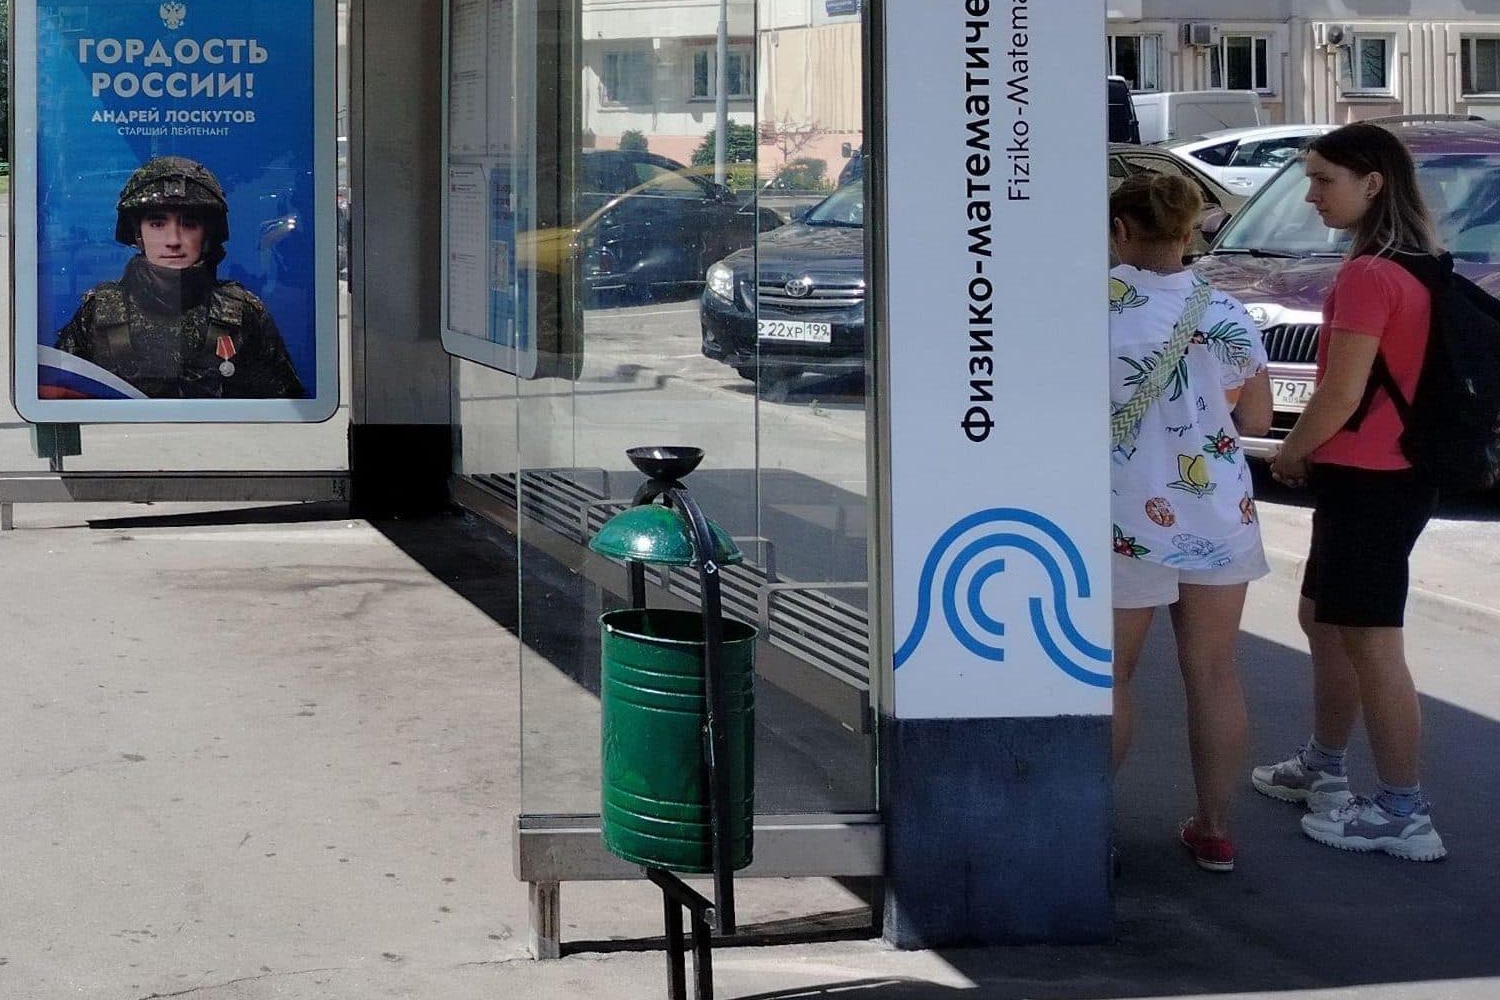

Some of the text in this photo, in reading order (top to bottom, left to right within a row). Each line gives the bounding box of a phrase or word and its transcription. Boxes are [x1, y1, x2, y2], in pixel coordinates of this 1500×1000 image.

[78, 38, 269, 67] ГОРДОСТЬ
[91, 72, 254, 98] РОССИИ!
[91, 107, 256, 124] АНДРЕЙ ЛОСКУТОВ
[117, 126, 229, 136] СТАРШИЙ ЛЕЙТЕНАНТ
[1274, 381, 1307, 398] 797
